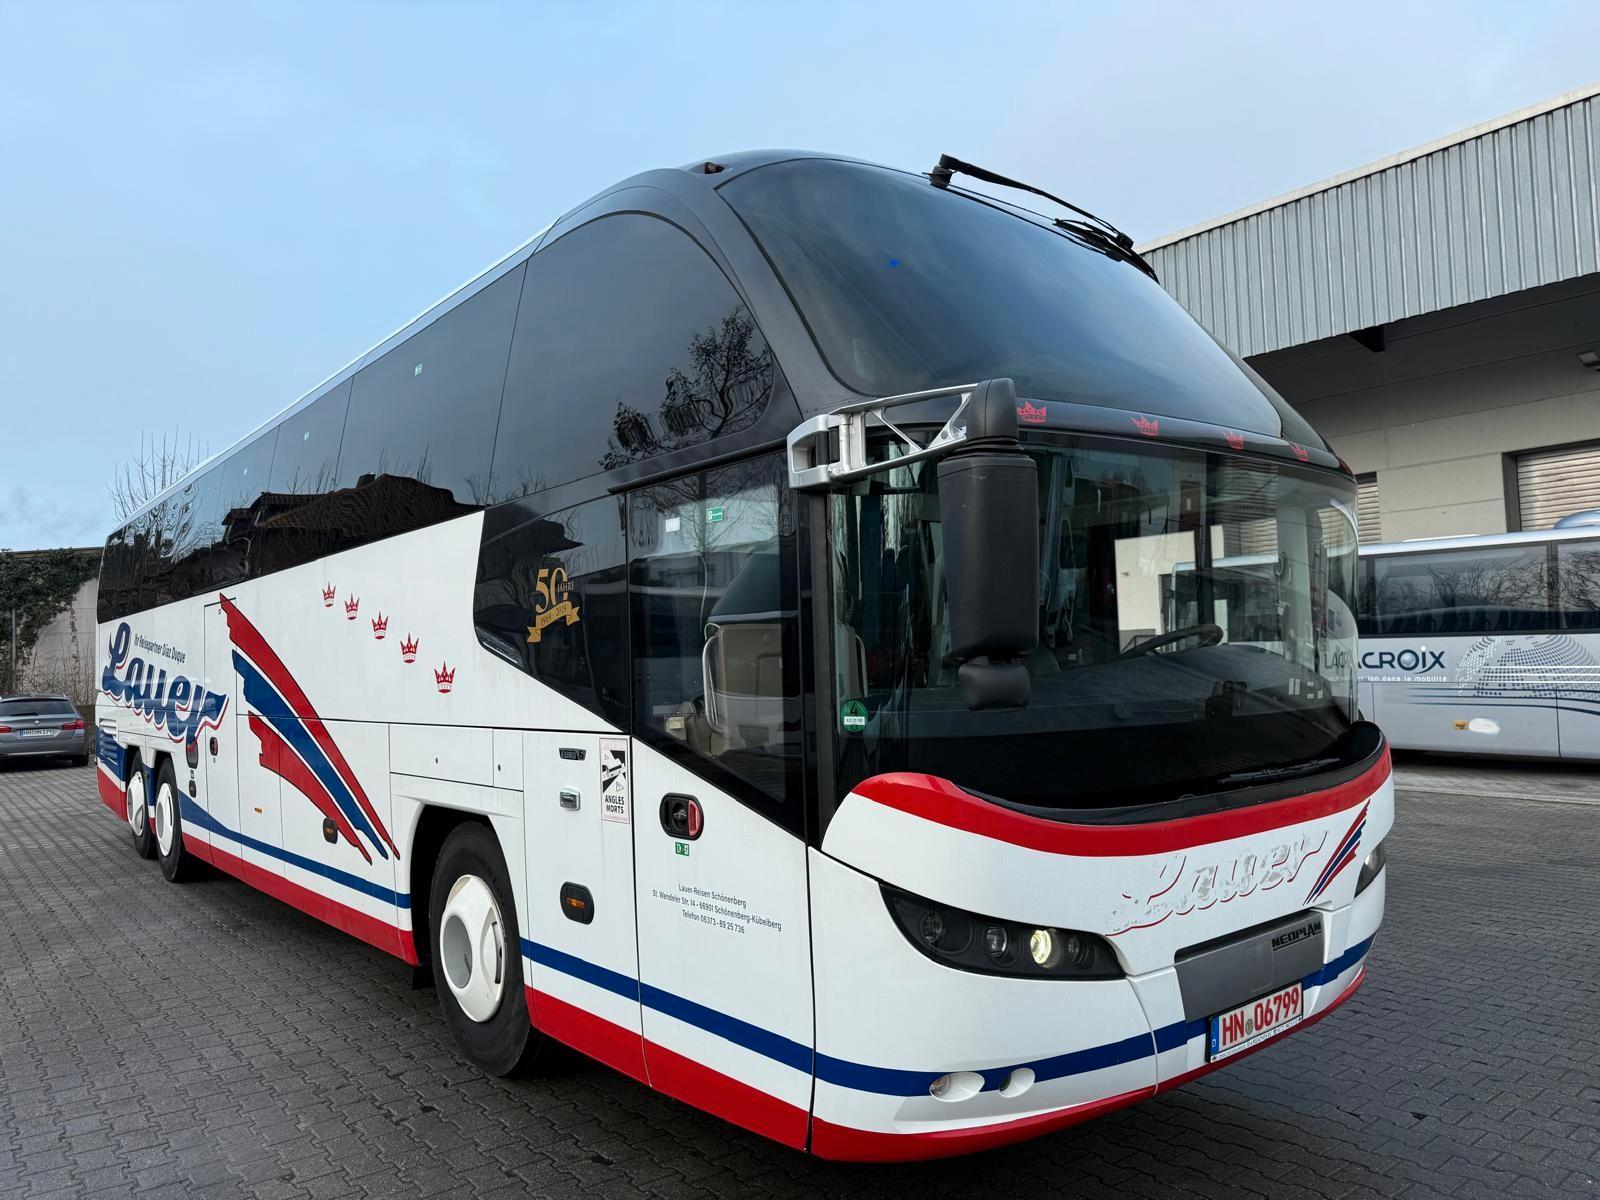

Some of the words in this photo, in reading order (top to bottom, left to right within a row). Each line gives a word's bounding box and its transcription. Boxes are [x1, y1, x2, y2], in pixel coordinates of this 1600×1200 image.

[535, 567, 569, 614] 50
[557, 581, 575, 594] JAHRE
[102, 622, 229, 752] Lauer
[850, 701, 859, 717] 4
[560, 750, 577, 760] EURO
[604, 794, 625, 805] ANGLES
[605, 804, 624, 814] MORTS
[678, 883, 711, 899] Lauer-Reisen
[711, 891, 747, 910] Schönenberg
[658, 890, 681, 903] Wendeler
[681, 896, 690, 906] Str.
[699, 901, 714, 912] 66901
[714, 905, 782, 932] Schönenberg-Kübelberg
[682, 909, 700, 921] Telefon
[700, 914, 716, 926] 06373
[1271, 921, 1322, 949] NEOPLAN
[1221, 1009, 1245, 1047] HN
[1253, 987, 1299, 1032] 06799
